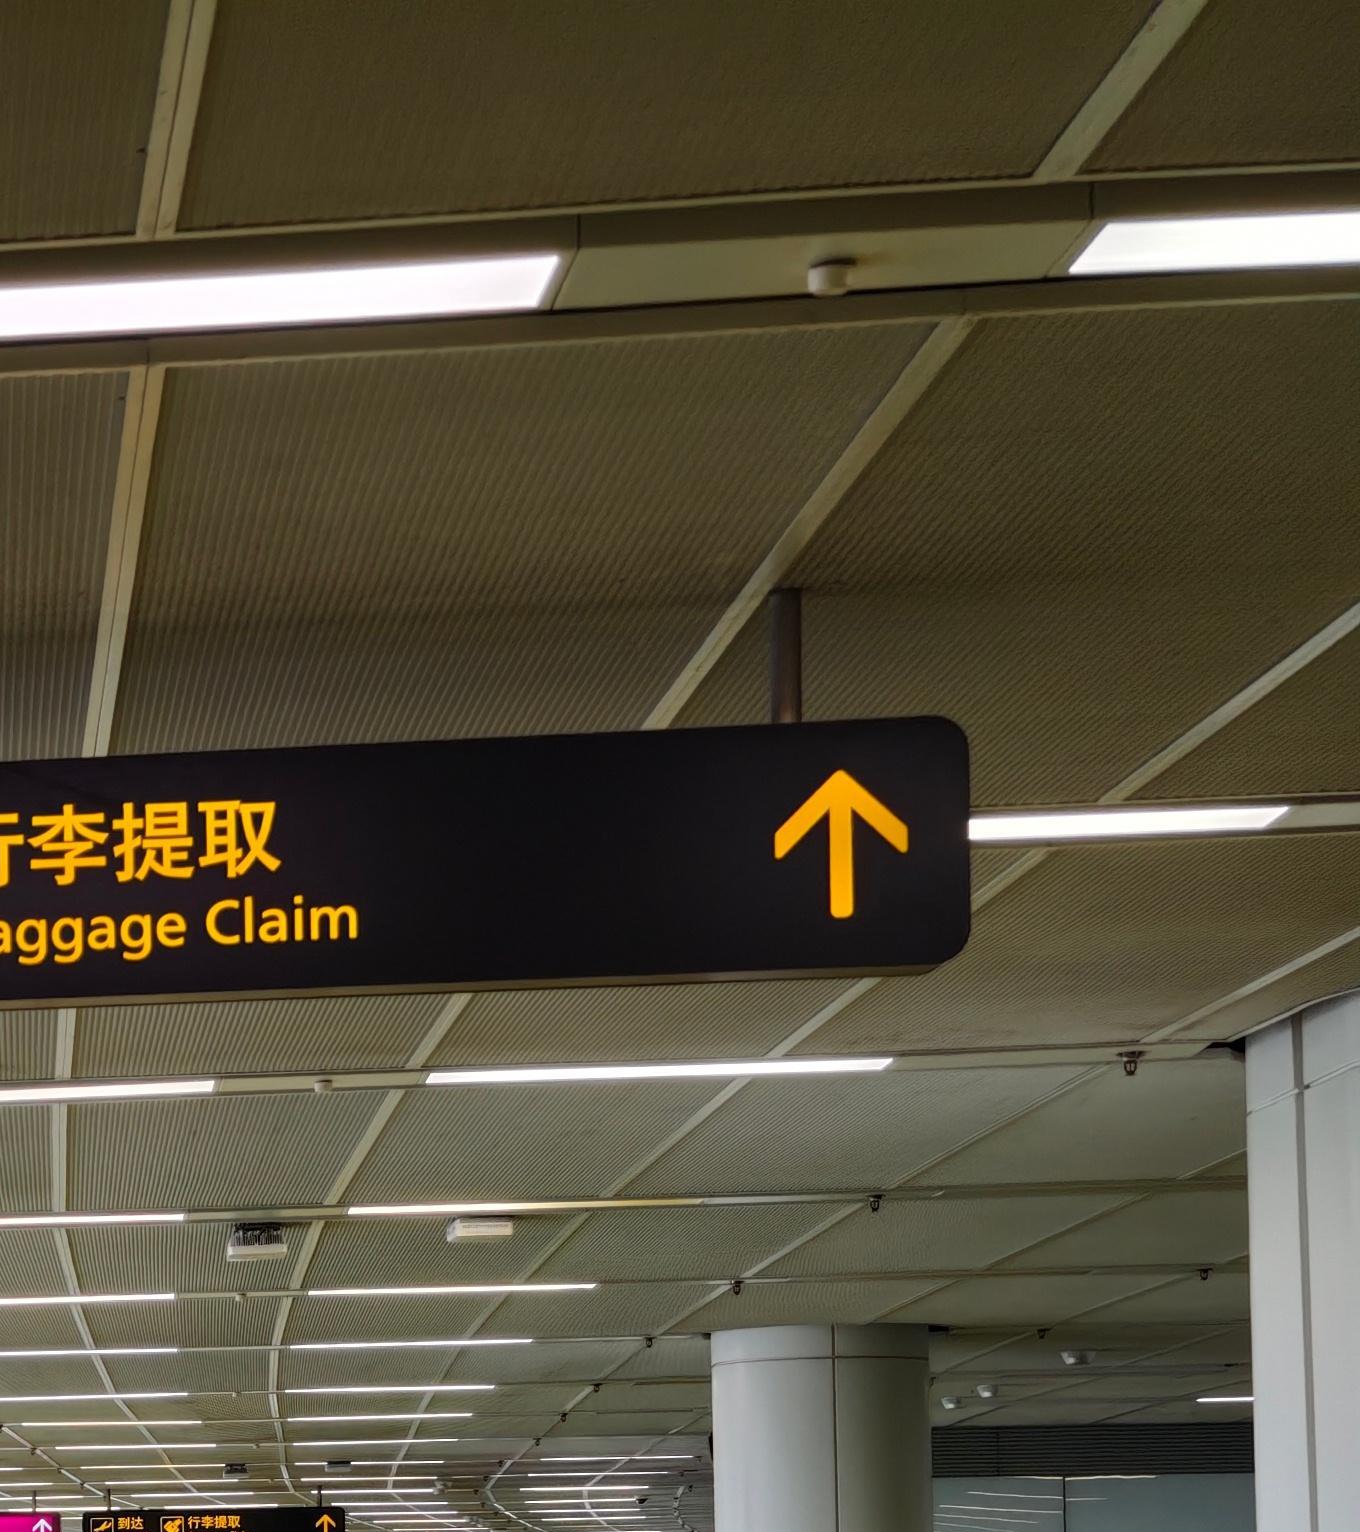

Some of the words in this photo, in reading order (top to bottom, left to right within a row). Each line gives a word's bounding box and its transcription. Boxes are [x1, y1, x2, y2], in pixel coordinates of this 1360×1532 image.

[205, 894, 358, 945] Claim
[117, 1516, 144, 1530] 到达
[187, 1515, 241, 1529] 行李提取
